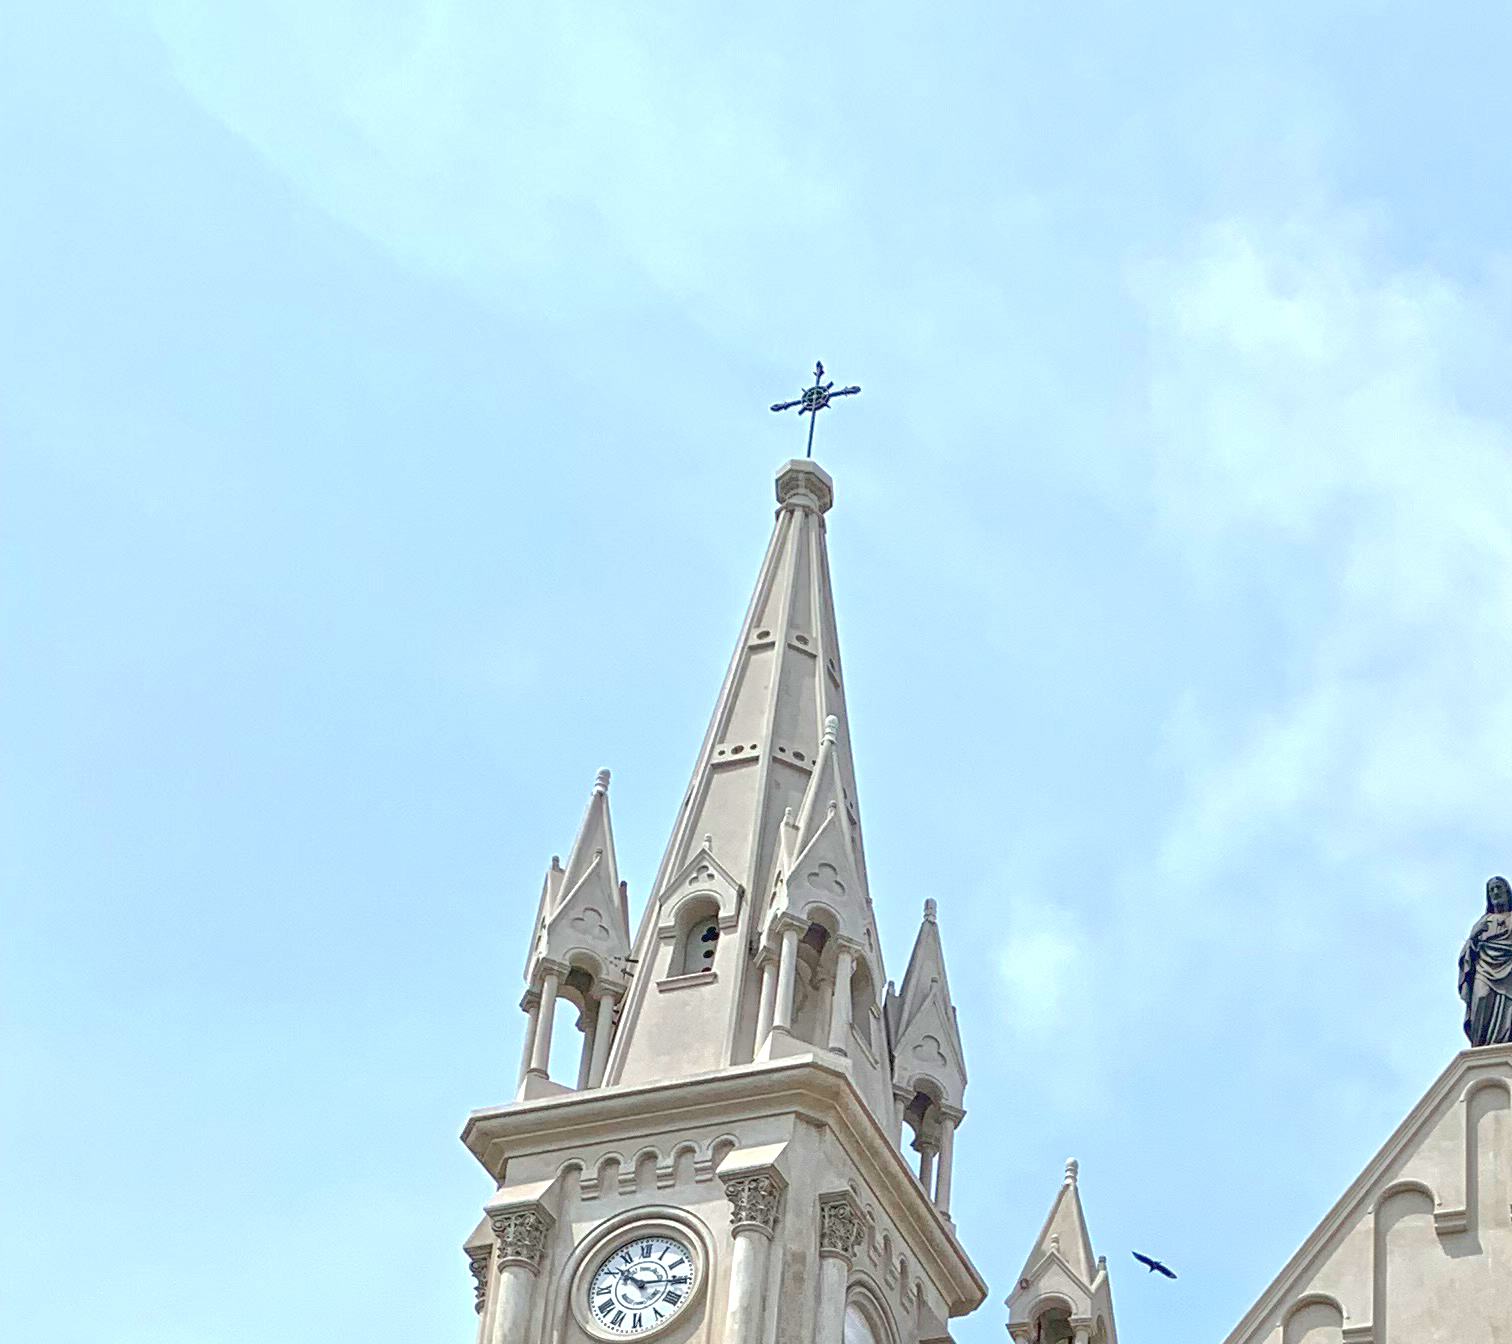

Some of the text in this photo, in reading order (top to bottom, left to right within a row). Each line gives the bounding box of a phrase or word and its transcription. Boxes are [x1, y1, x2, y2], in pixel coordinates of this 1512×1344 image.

[620, 1251, 634, 1267] XI
[658, 1246, 670, 1261] I
[604, 1267, 619, 1278] X
[596, 1284, 612, 1296] IX
[632, 1312, 643, 1329] VI
[653, 1307, 665, 1321] V
